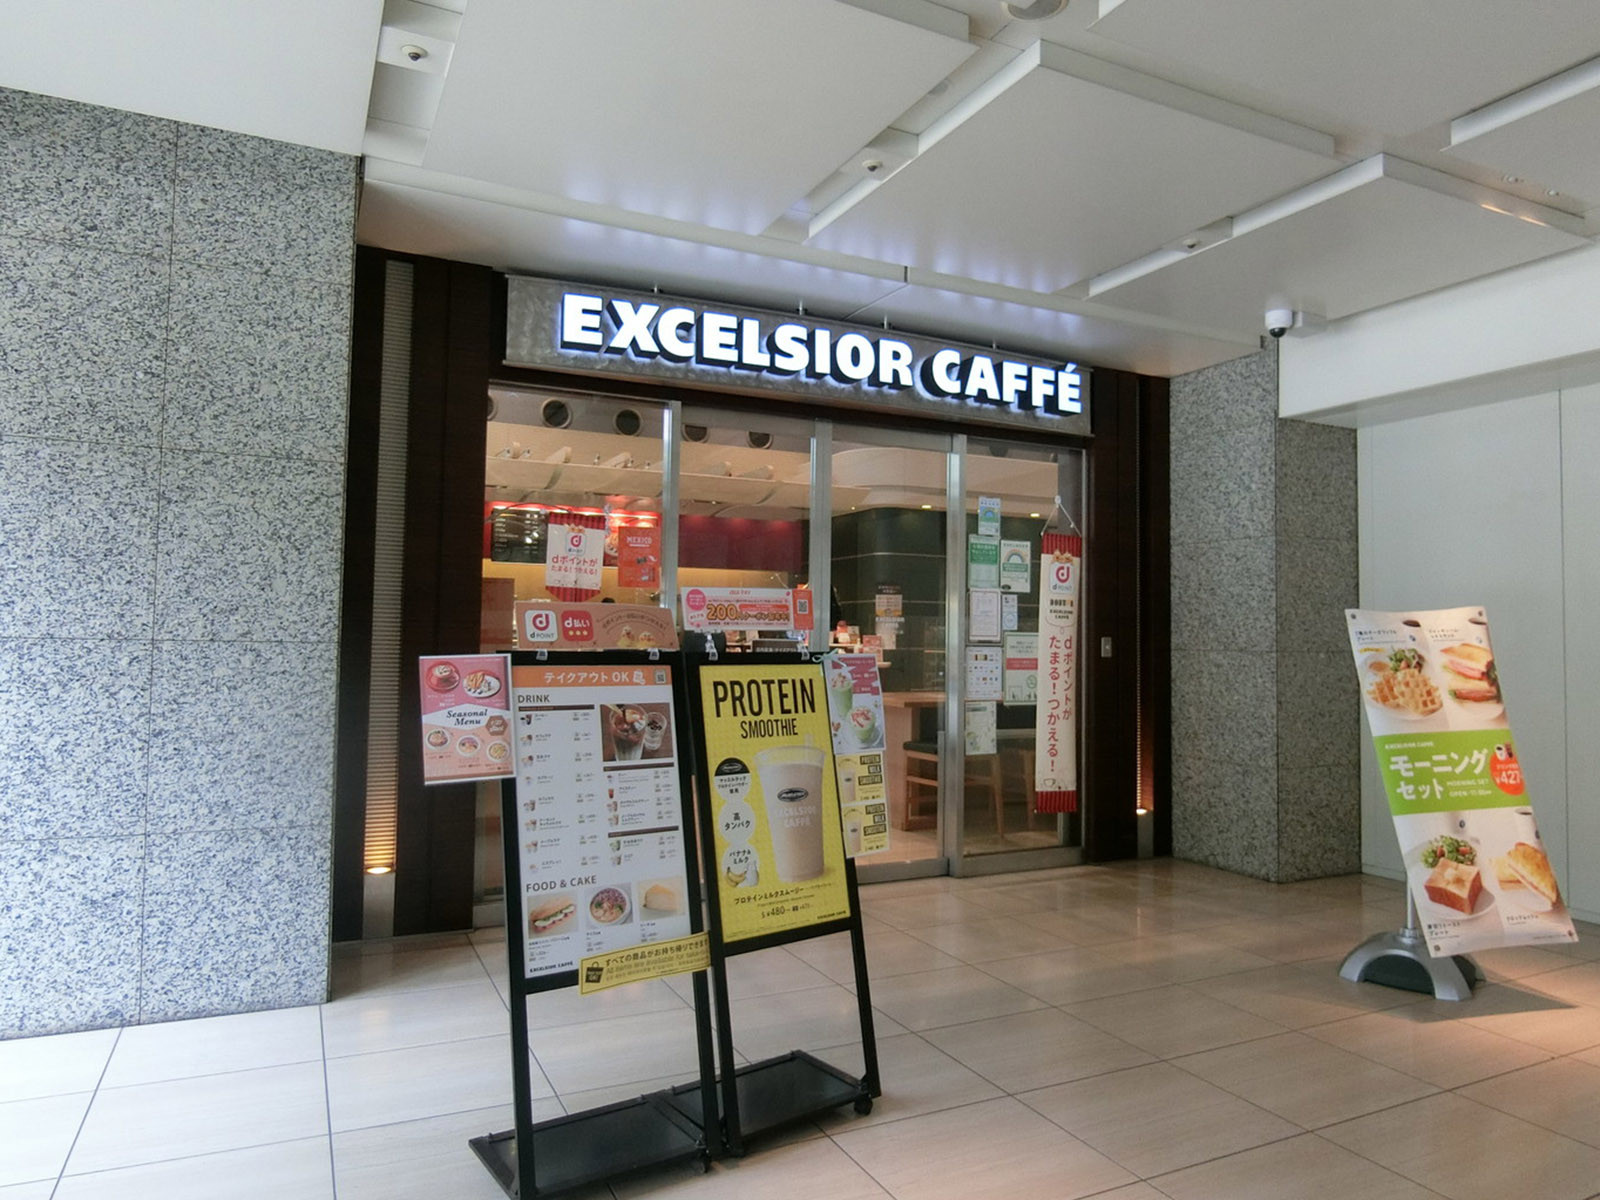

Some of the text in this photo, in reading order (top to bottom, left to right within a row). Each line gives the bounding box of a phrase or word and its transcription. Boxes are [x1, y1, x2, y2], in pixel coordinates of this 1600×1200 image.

[561, 293, 1082, 414] EXCELSIOR CAFFÉ
[626, 536, 652, 545] MEXICO
[551, 554, 598, 567] dポイントが
[564, 616, 590, 628] d払い
[544, 671, 629, 685] テイクアウト OK
[1062, 634, 1073, 720] dポイントが
[517, 694, 550, 704] DRINK
[712, 678, 816, 718] PROTEIN
[446, 708, 488, 719] Seasonal
[454, 718, 481, 727] Menu
[740, 718, 798, 739] SMOOTHIE
[1389, 747, 1489, 778] モーニング
[1396, 777, 1444, 801] セット
[733, 856, 750, 865] ミルク
[526, 875, 597, 893] FOOD & CAKE
[735, 887, 804, 905] プロテインミルクスムージー
